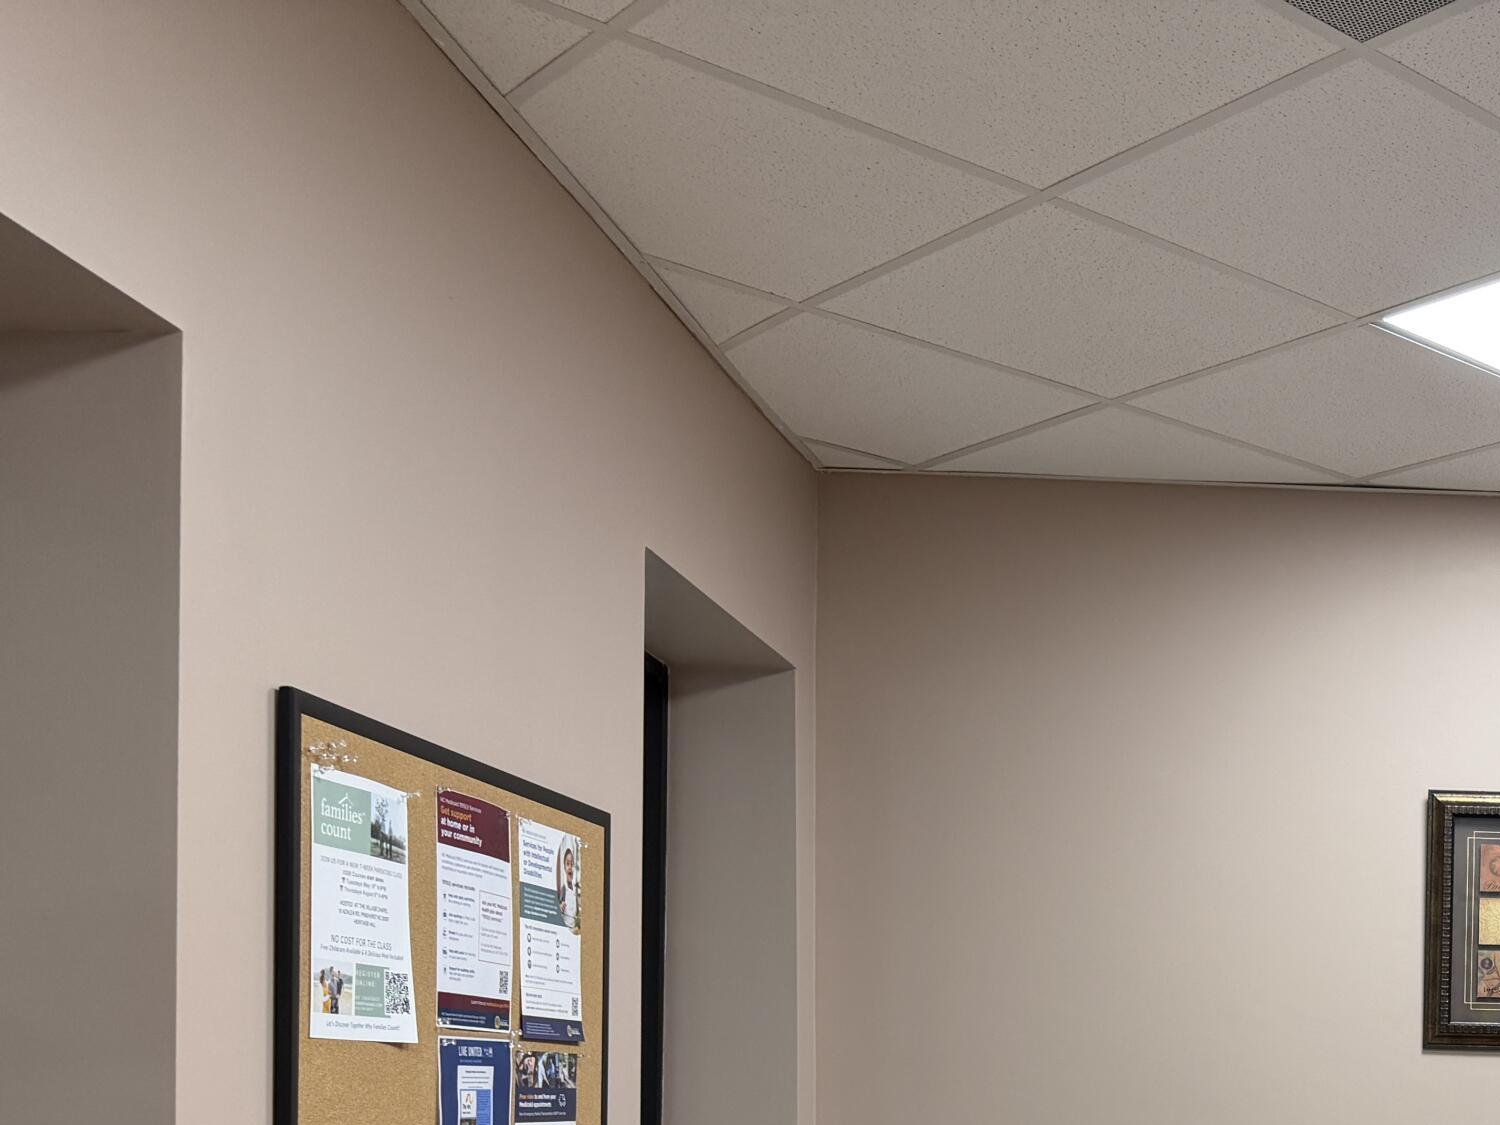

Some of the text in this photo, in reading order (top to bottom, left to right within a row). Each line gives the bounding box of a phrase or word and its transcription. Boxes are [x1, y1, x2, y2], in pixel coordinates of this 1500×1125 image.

[321, 797, 362, 825] families
[440, 806, 472, 822] Get support
[321, 822, 352, 841] count
[440, 817, 476, 834] at home or in
[441, 829, 482, 848] your community
[330, 934, 392, 951] NO COST FOR THE CLASS
[458, 1046, 468, 1057] LIVE
